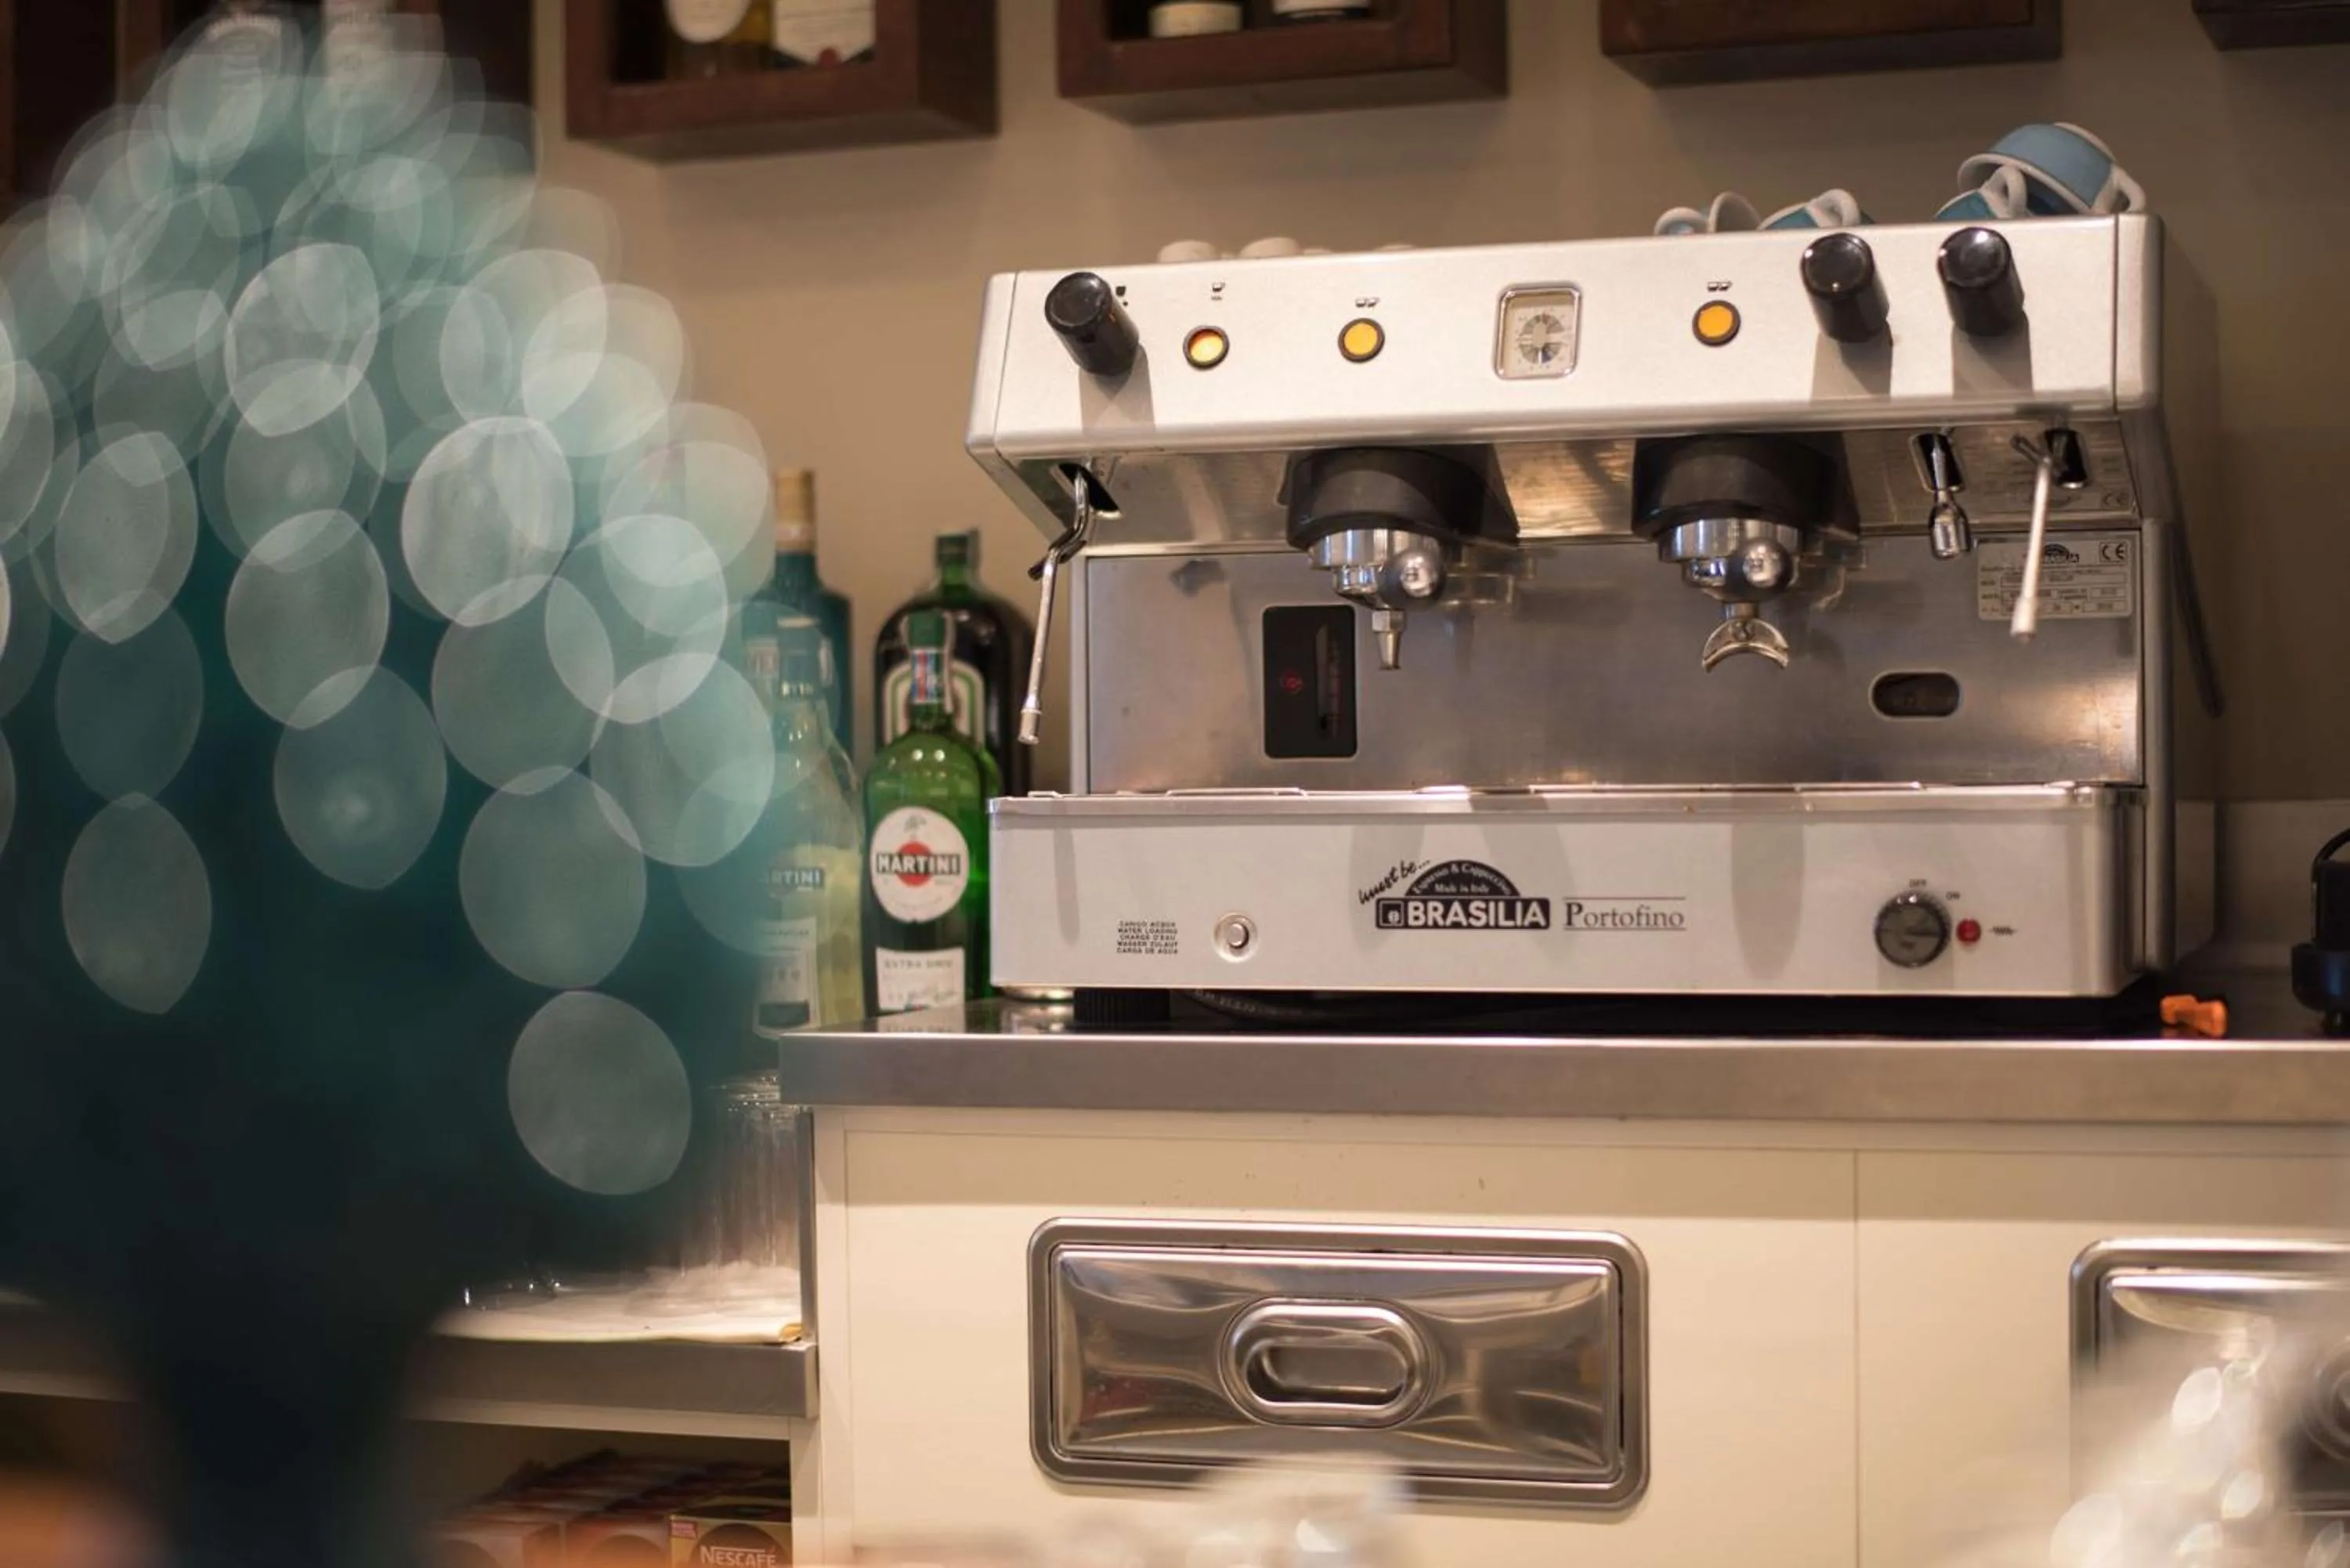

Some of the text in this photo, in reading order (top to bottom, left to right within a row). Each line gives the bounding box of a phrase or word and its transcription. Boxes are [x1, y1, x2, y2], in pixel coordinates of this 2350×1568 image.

[2102, 543, 2126, 561] CE
[877, 854, 960, 875] MARTINI
[763, 867, 822, 886] RTINI
[1407, 901, 1547, 927] BRASILIA
[1566, 901, 1684, 928] Portofino
[700, 1545, 777, 1567] NESCAFÉ
